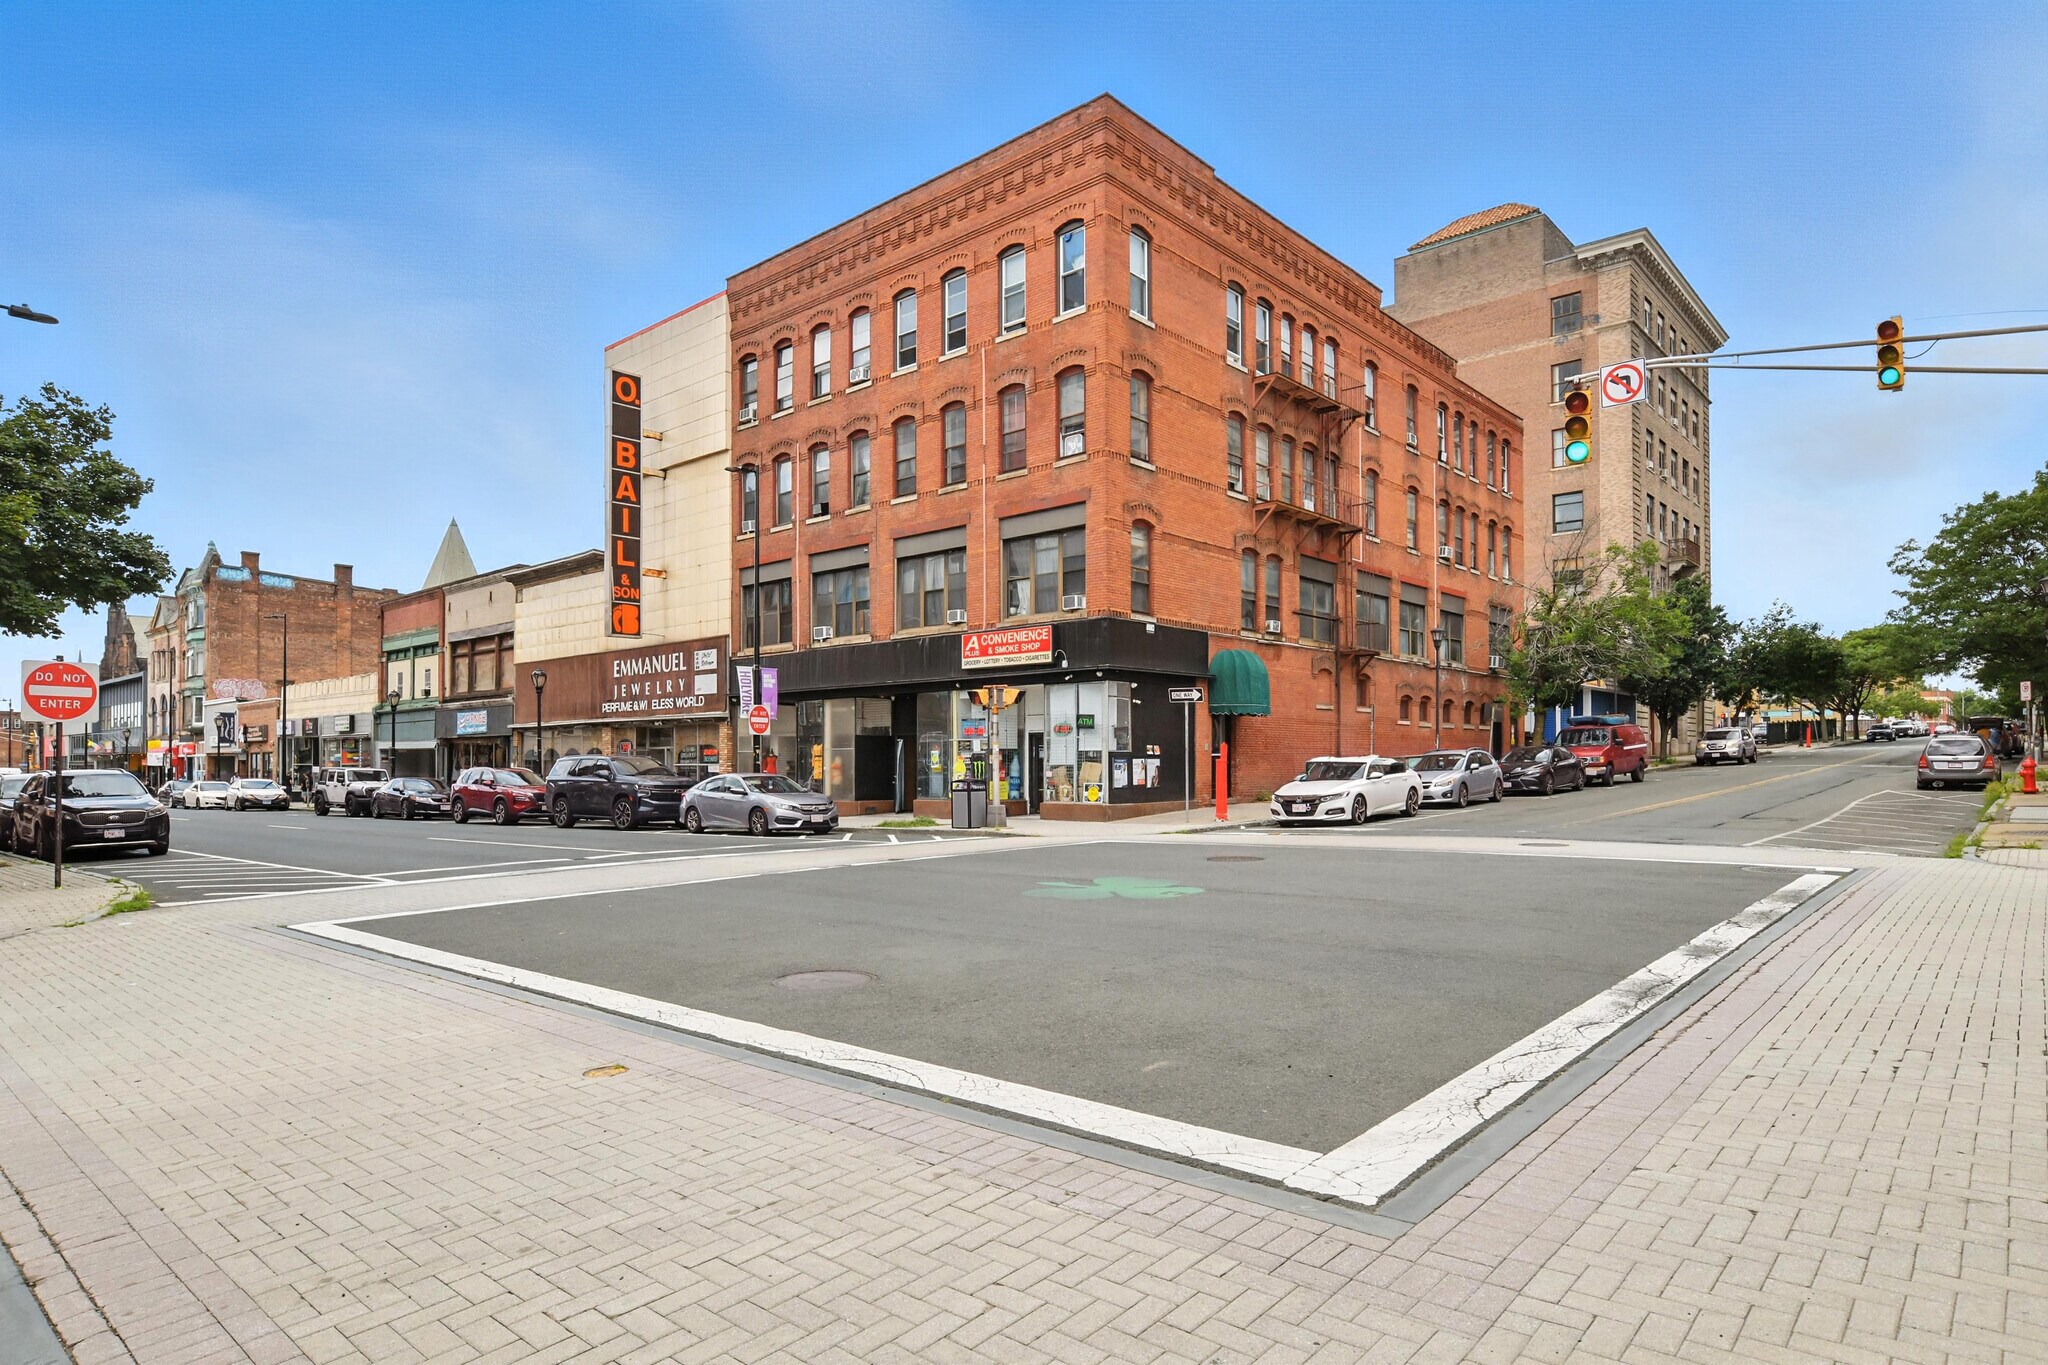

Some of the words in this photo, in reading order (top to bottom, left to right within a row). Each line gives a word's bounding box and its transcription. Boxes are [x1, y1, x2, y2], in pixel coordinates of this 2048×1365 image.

[621, 573, 630, 585] &
[614, 586, 640, 600] SON
[965, 635, 980, 651] A
[981, 628, 1049, 646] CONVENIENCE
[994, 644, 1019, 654] SMOKE
[1021, 642, 1040, 651] SHOP
[1025, 653, 1050, 661] CIGARETTES
[613, 652, 687, 678] EMMANUEL
[35, 672, 54, 682] DO
[63, 674, 87, 683] NOT
[40, 698, 81, 709] ENTER
[675, 696, 705, 708] WORLD
[1078, 717, 1093, 725] ATM
